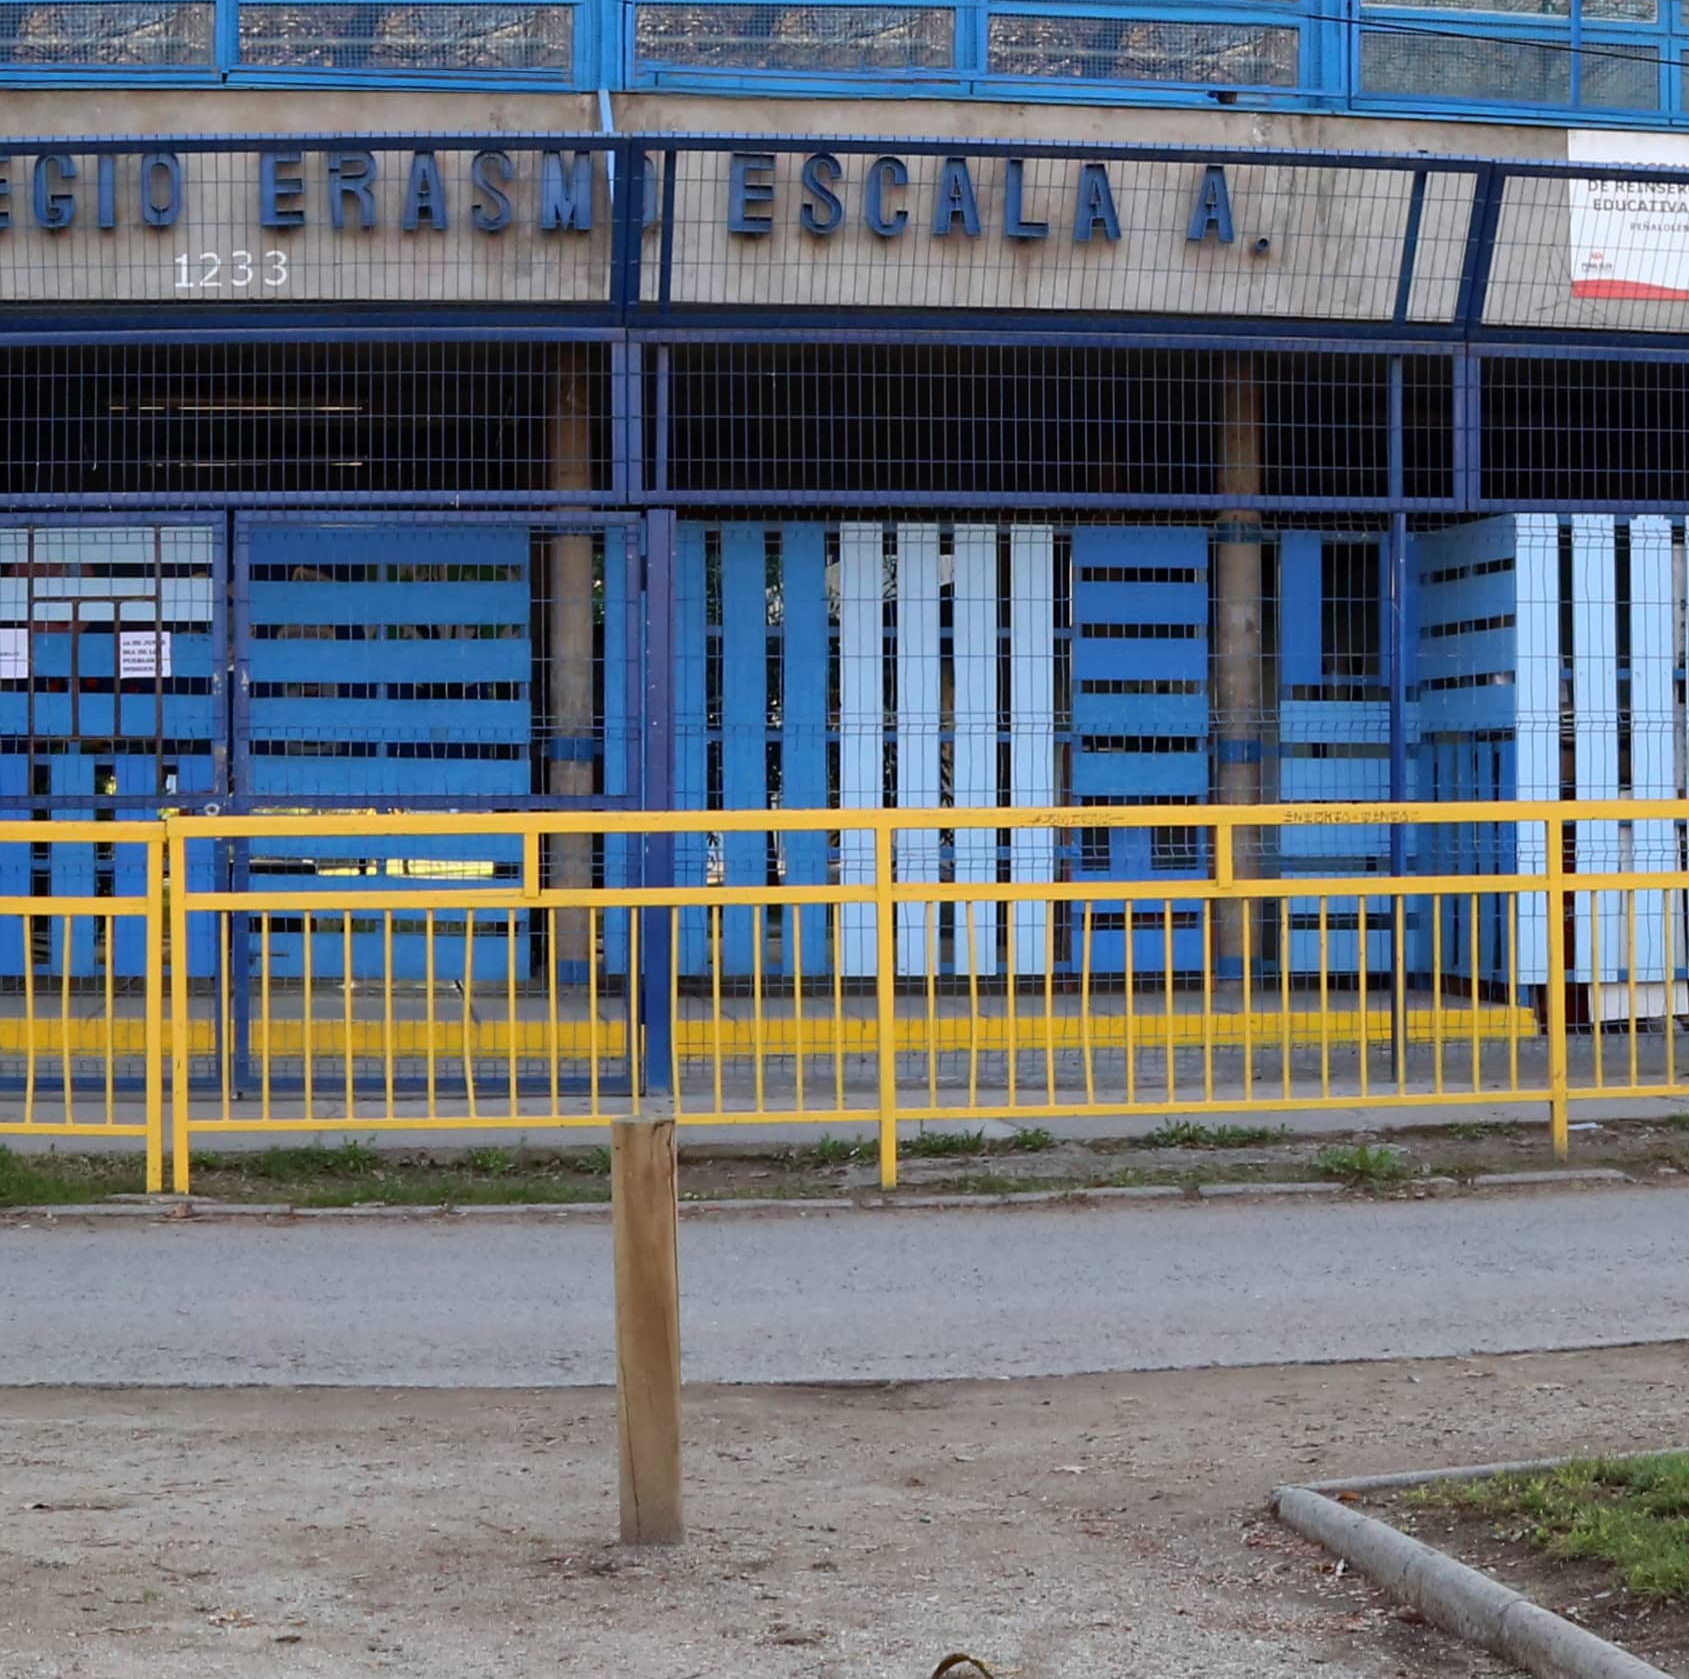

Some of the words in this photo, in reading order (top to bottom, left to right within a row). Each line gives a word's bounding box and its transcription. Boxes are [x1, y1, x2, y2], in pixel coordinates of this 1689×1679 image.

[727, 152, 1122, 242] ESCALA
[1186, 163, 1271, 254] A.
[1593, 198, 1689, 213] EDUCATIVA
[174, 250, 289, 288] 1233
